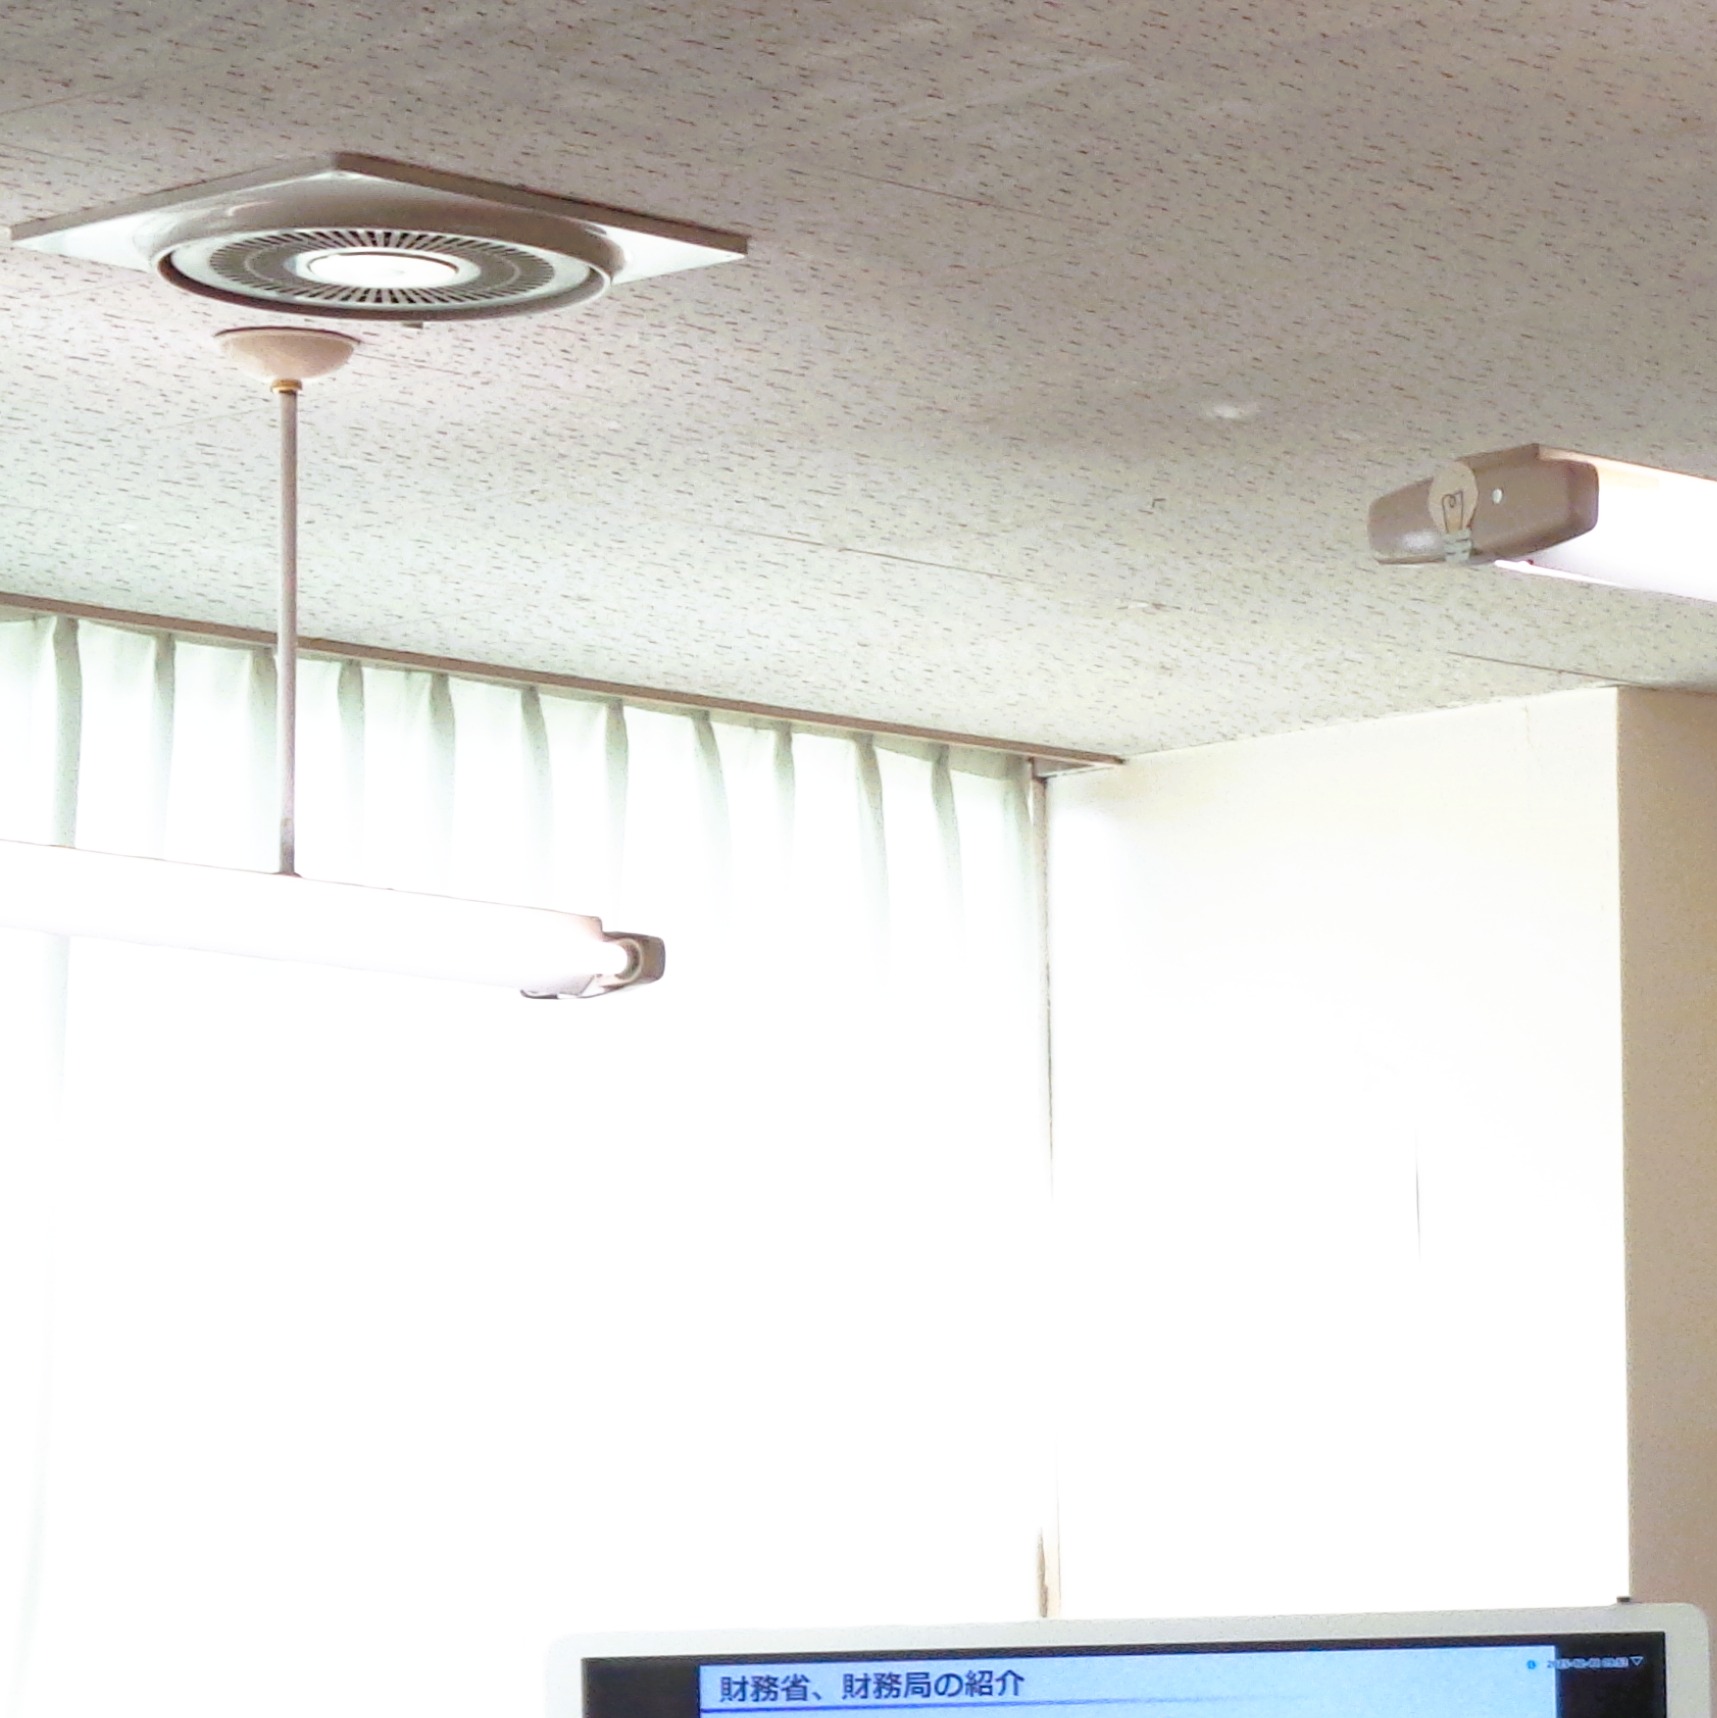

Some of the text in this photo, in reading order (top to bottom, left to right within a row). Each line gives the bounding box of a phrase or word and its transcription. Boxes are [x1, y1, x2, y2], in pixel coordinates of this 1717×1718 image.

[719, 1669, 1026, 1702] 財務省、財務局の紹介
